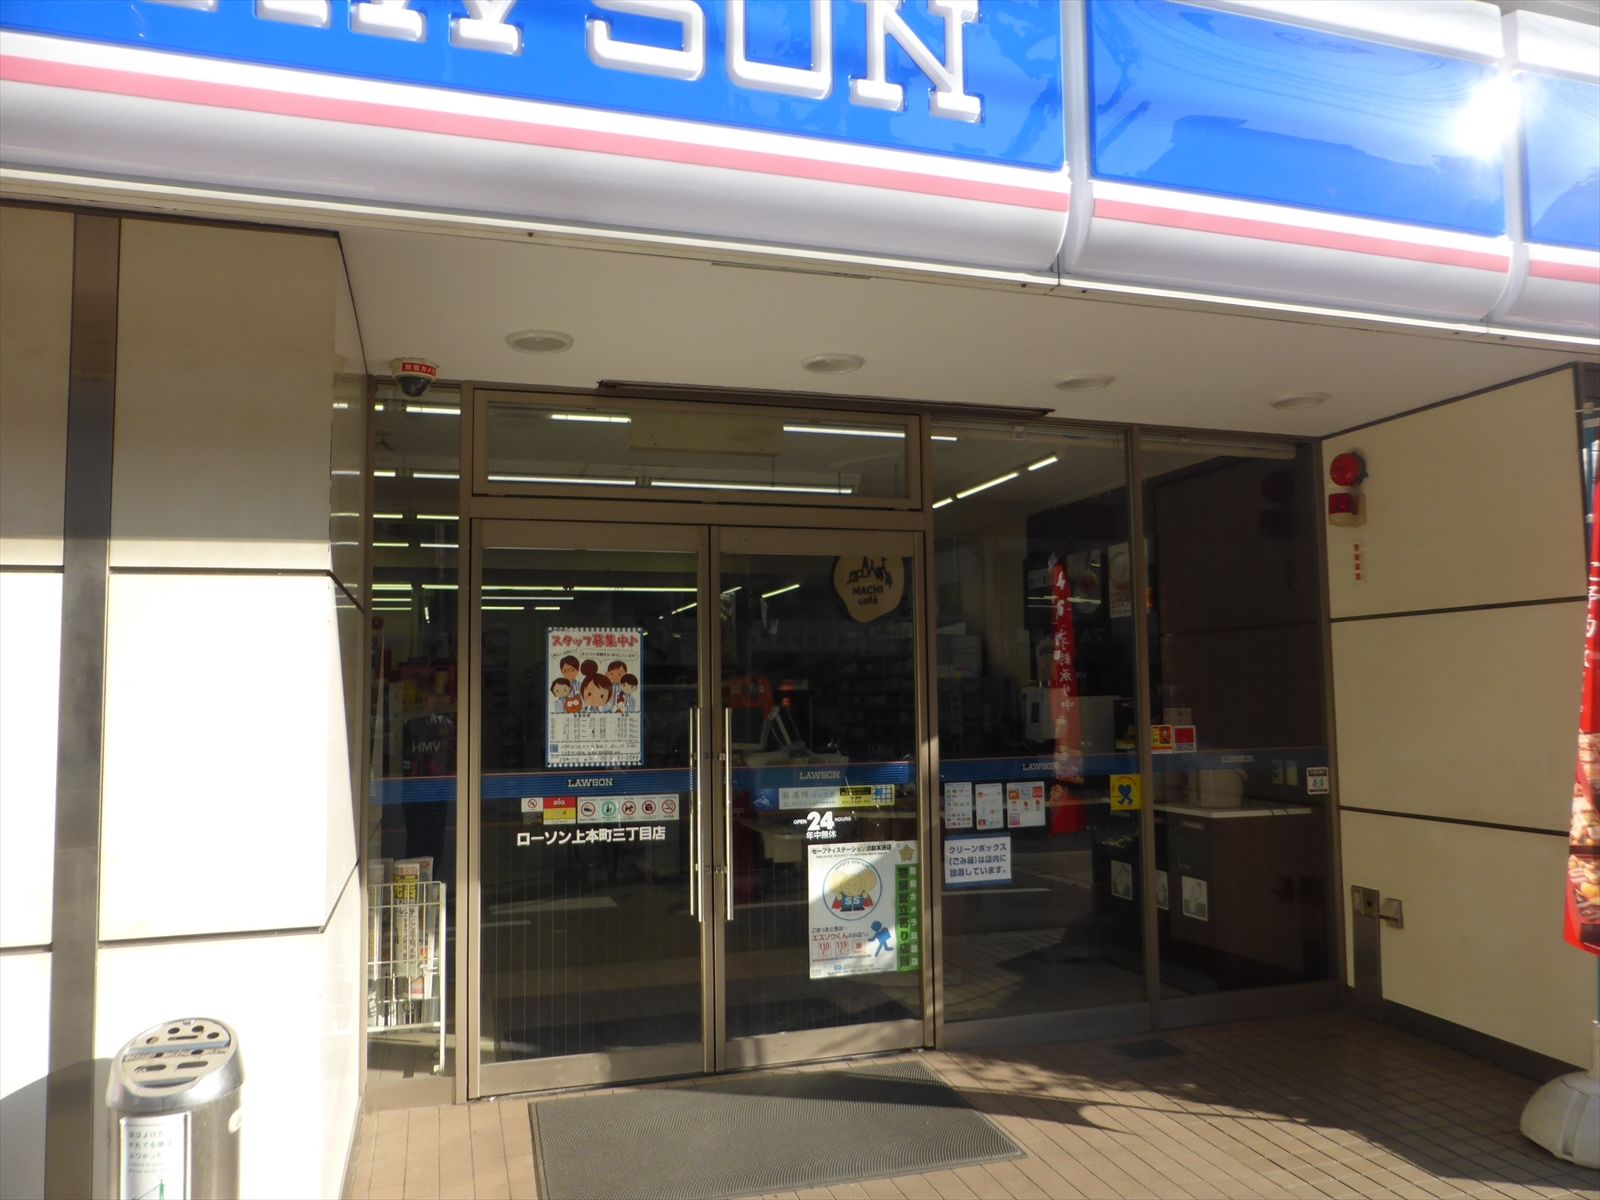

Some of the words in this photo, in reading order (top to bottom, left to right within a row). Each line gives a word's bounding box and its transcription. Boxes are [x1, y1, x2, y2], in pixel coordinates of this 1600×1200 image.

[852, 585, 884, 595] MACHI
[411, 741, 441, 753] HMV
[799, 771, 840, 780] LAWSON
[568, 778, 614, 788] LAWSON
[806, 810, 835, 831] 24
[516, 826, 666, 846] ローソン上本町三丁目店
[806, 830, 837, 839] 年中無休
[948, 843, 1007, 855] クリーンボックス
[949, 865, 1007, 878] 設置しています。
